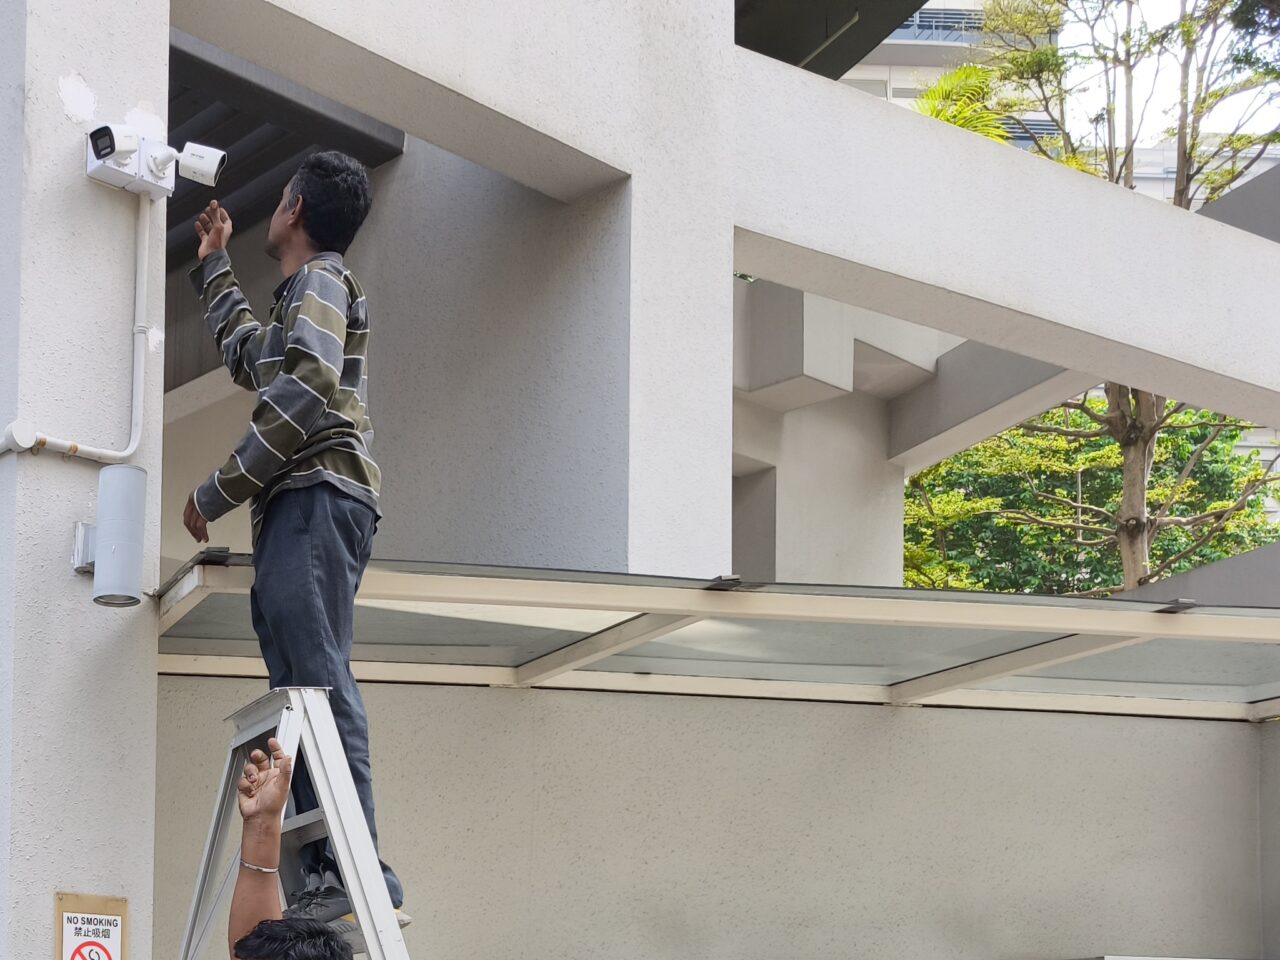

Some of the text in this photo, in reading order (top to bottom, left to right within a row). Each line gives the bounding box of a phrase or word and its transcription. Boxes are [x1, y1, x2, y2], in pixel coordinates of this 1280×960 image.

[66, 916, 119, 928] NO SMOKING
[73, 926, 111, 939] 禁止吸烟
